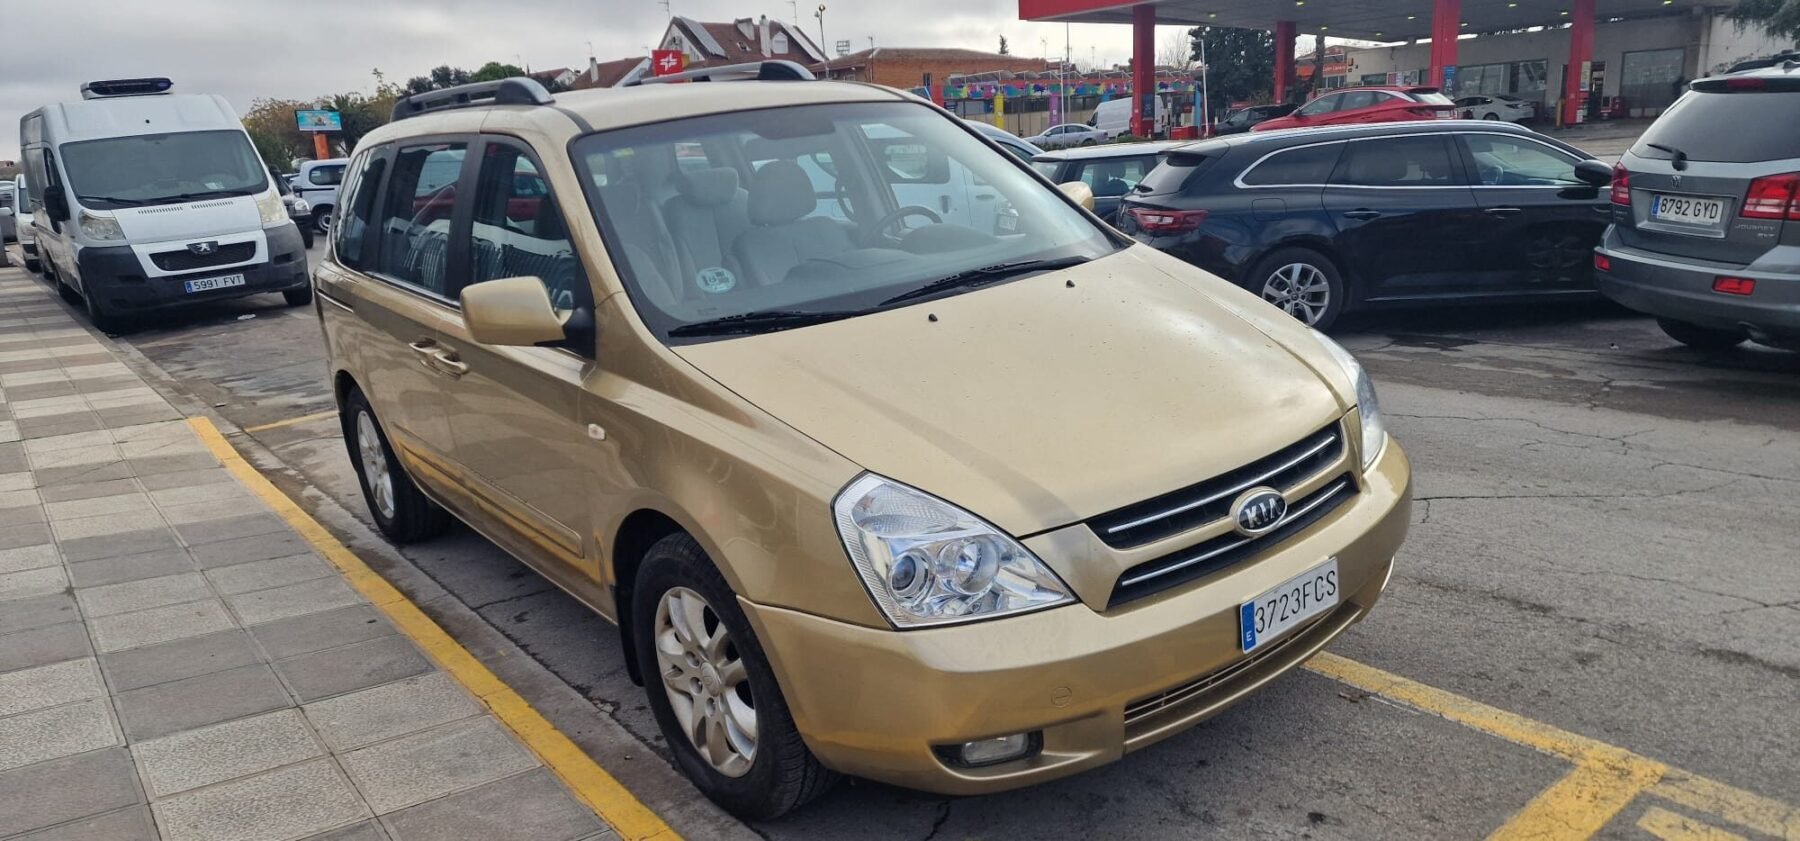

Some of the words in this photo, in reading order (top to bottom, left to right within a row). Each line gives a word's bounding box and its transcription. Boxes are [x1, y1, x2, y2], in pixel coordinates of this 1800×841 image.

[1660, 198, 1691, 216] 8792
[1693, 201, 1719, 220] GYD
[193, 279, 219, 290] 5991
[223, 275, 242, 286] FVT
[1245, 497, 1282, 528] KIA
[1254, 569, 1337, 634] 3723FCS
[1245, 630, 1253, 642] E
